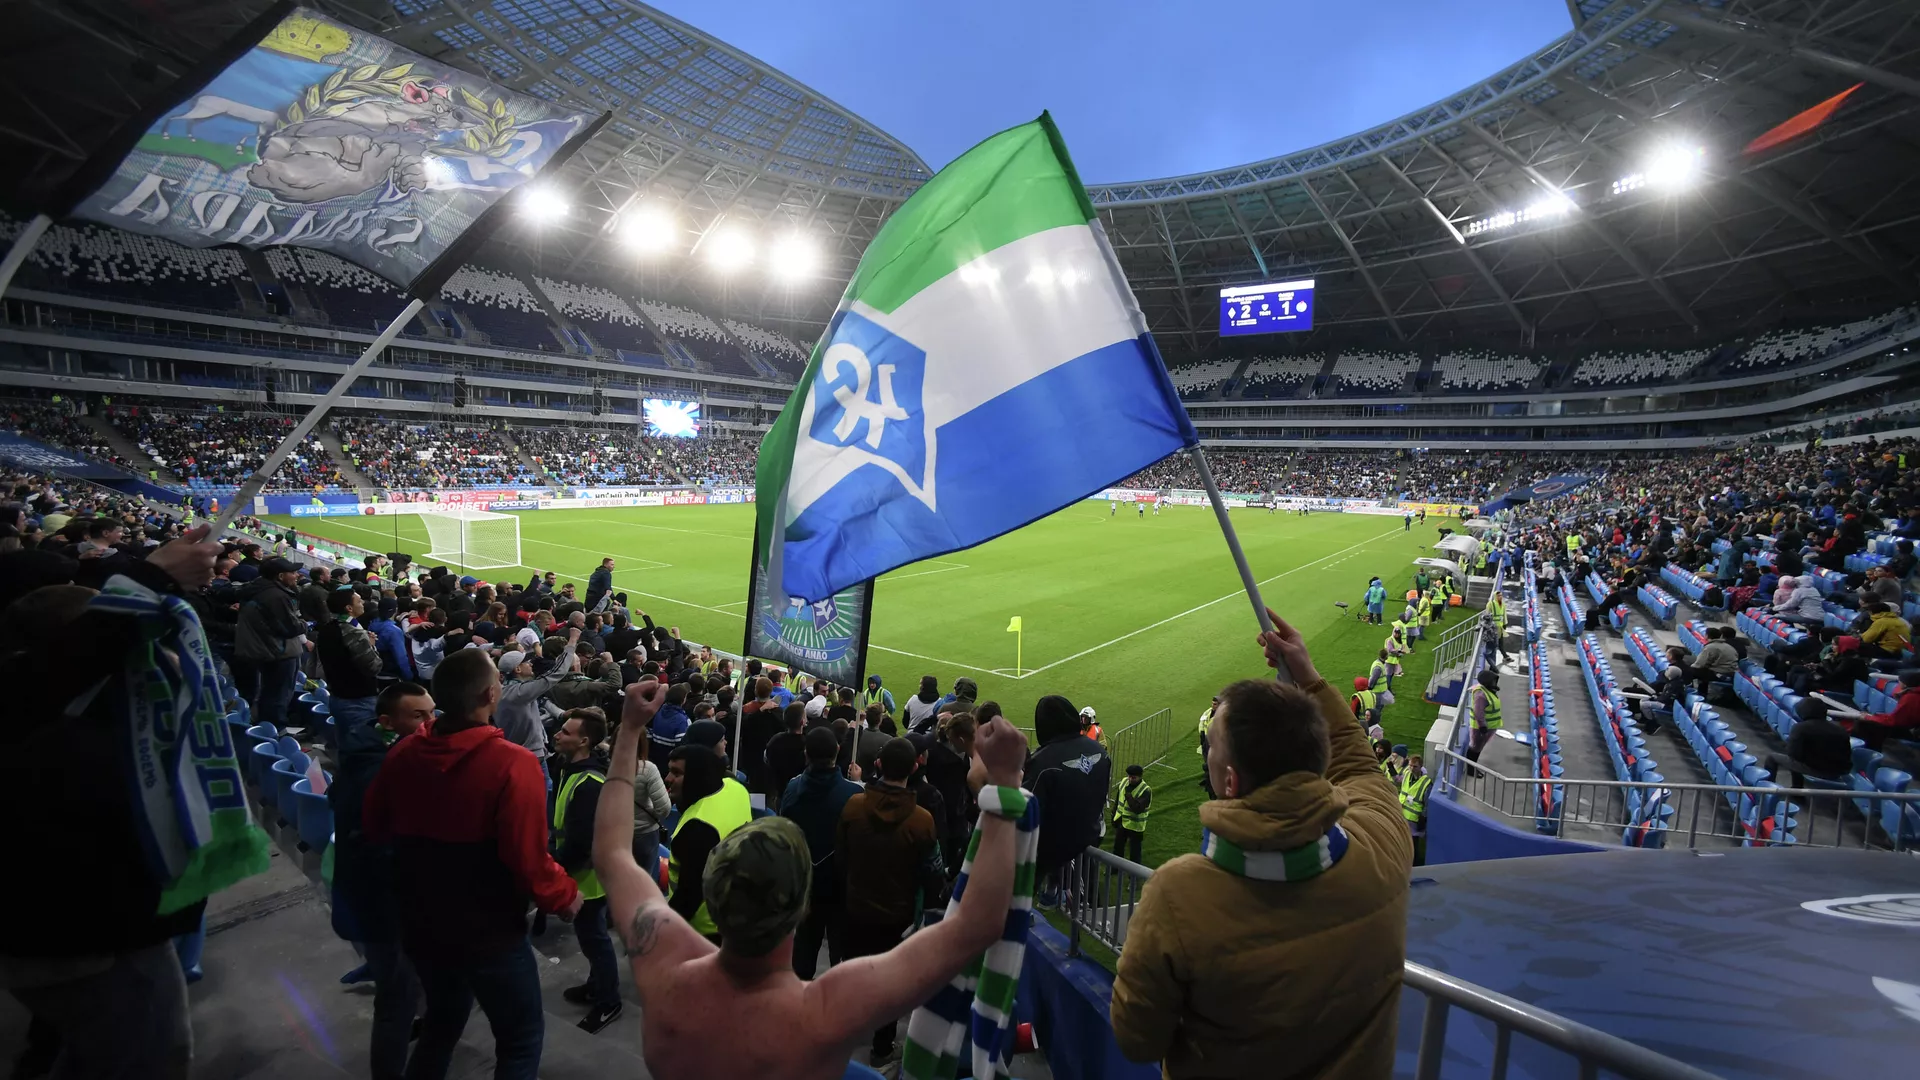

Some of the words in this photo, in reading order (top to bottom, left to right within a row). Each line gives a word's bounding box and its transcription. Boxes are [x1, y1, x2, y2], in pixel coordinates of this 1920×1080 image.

[1241, 305, 1251, 319] 2
[1281, 301, 1290, 315] 1
[665, 496, 704, 504] FONBET.RU
[709, 495, 742, 504] 1FNL.RU
[437, 501, 488, 511] ФОНБЕТ
